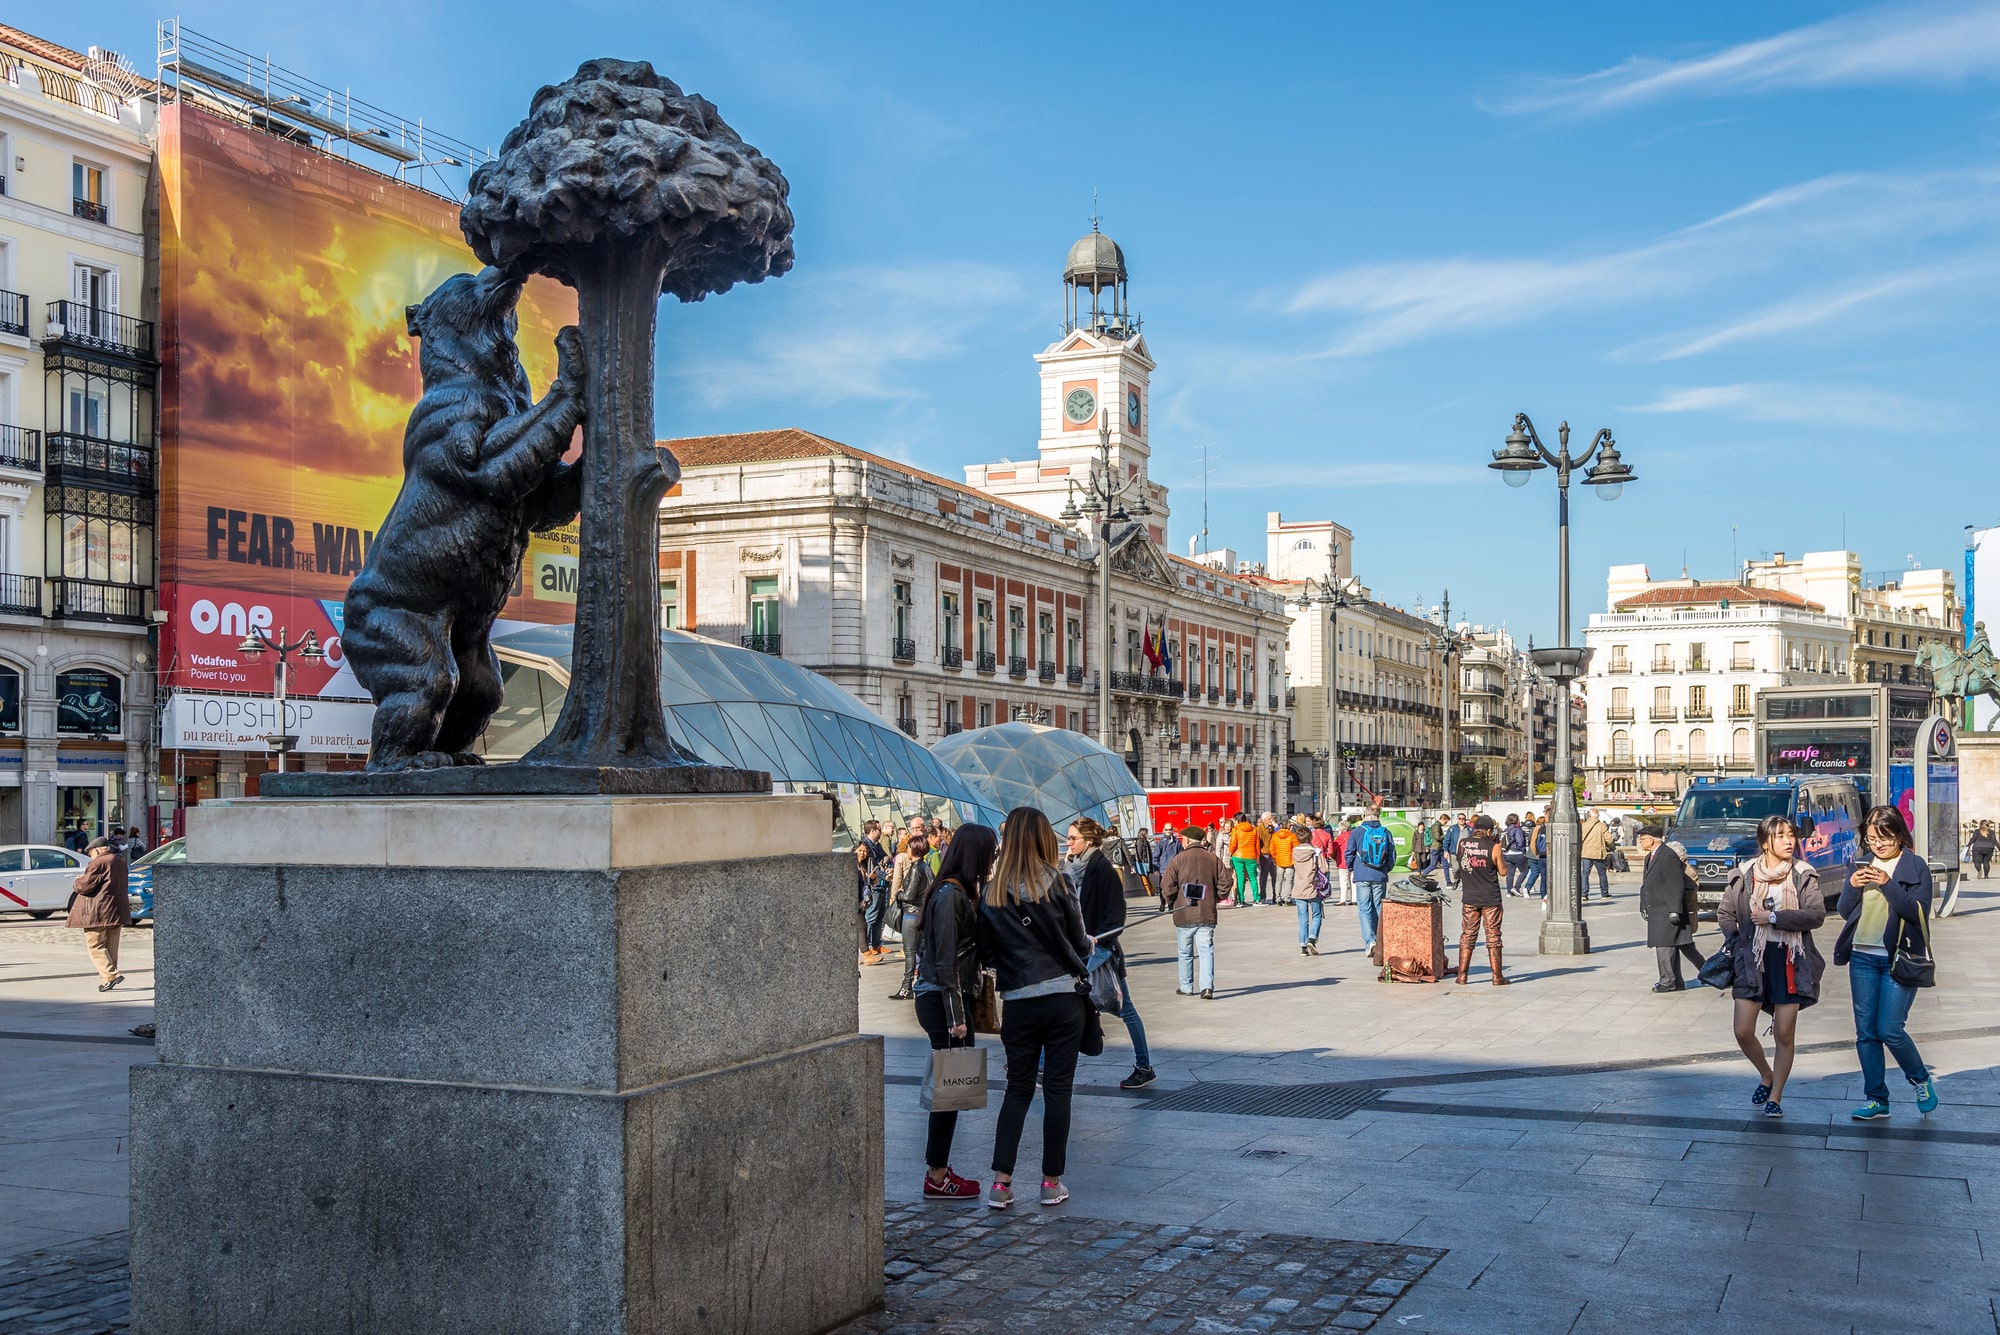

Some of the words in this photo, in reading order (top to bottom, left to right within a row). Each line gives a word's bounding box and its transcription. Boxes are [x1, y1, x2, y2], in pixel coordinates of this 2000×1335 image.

[207, 506, 294, 569] FEAR
[295, 551, 315, 572] THE
[561, 533, 579, 545] EPISO
[563, 545, 571, 555] EN
[541, 564, 578, 593] aM
[191, 654, 237, 667] Vodafone
[191, 668, 218, 681] Power
[219, 670, 228, 681] to
[230, 673, 246, 684] you
[186, 698, 313, 729] TOPSHOP
[237, 734, 254, 743] au
[356, 738, 370, 746] au
[1781, 746, 1819, 762] renfe
[1810, 758, 1846, 768] Cercanías
[943, 1077, 980, 1087] MANGO
[944, 1182, 960, 1195] N
